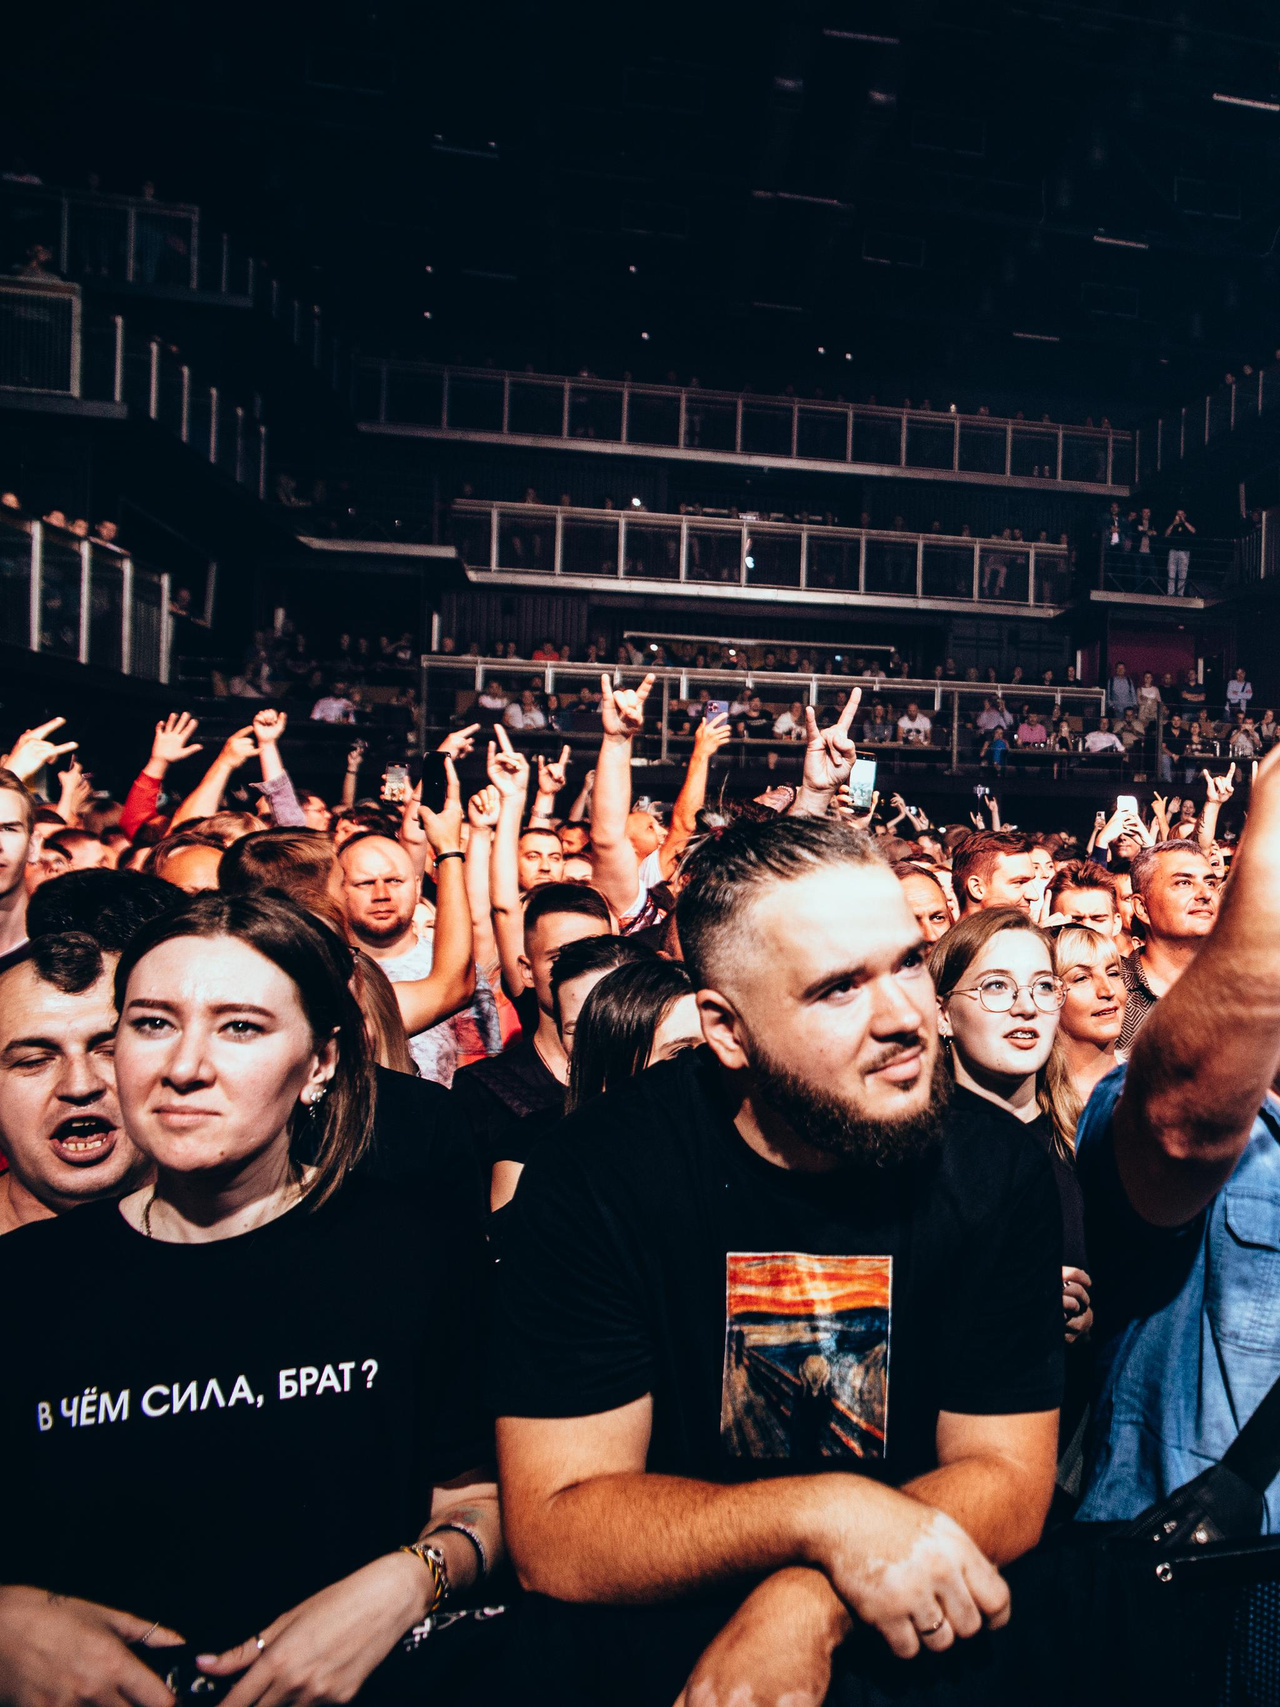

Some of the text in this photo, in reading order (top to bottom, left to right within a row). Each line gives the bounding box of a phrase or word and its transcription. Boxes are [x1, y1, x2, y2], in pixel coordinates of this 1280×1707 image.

[37, 1401, 53, 1432] В
[60, 1386, 130, 1428] ЧЁМ
[141, 1374, 265, 1418] СИЛА,
